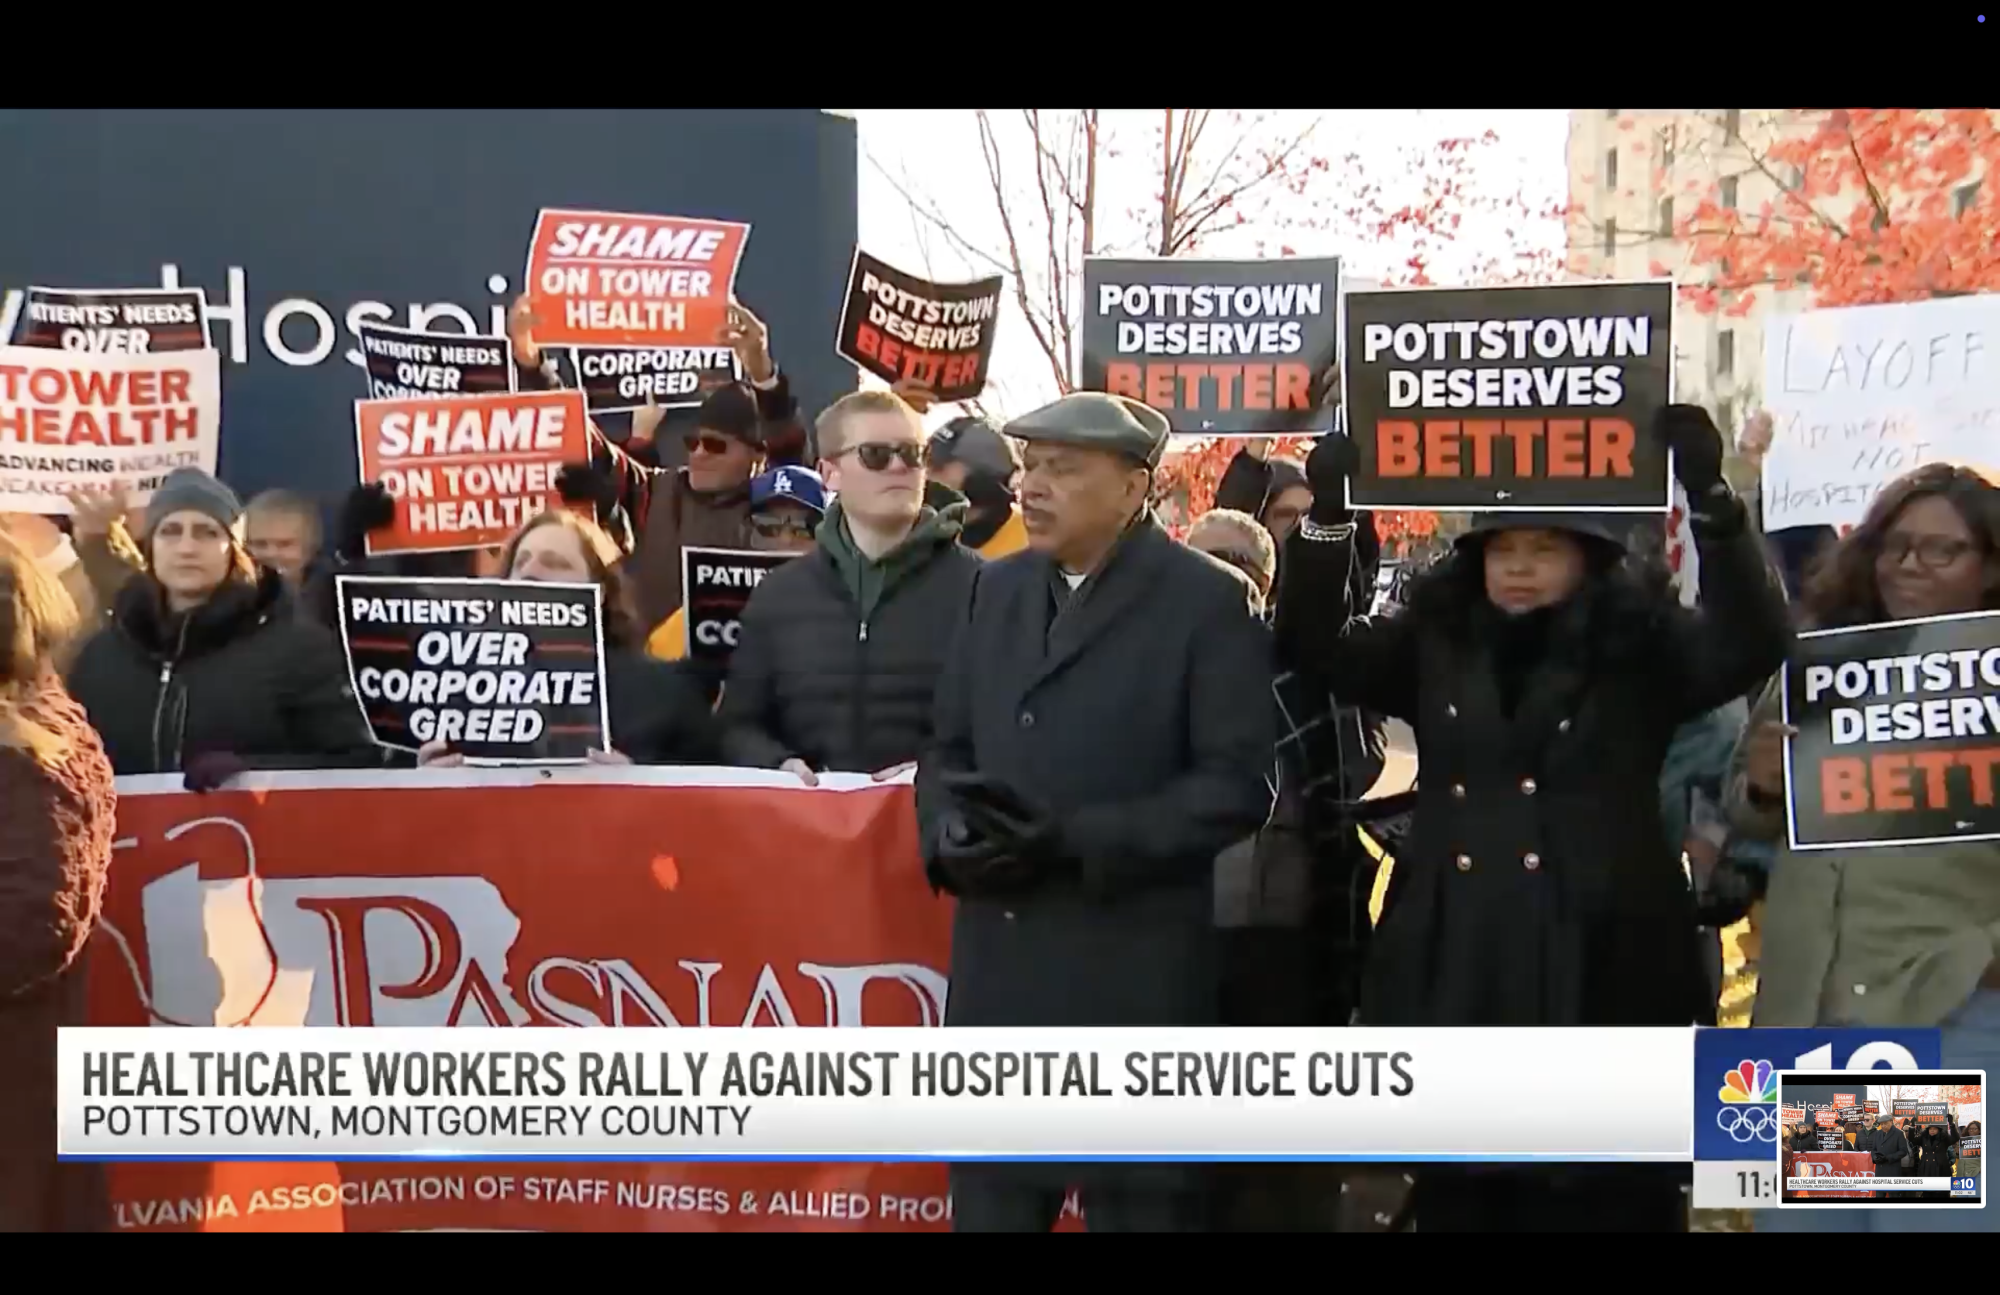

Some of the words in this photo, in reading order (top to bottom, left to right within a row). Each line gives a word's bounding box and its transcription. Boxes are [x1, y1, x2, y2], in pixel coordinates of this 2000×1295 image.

[548, 222, 725, 261] SHAME
[541, 267, 590, 295] ON
[599, 268, 712, 297] TOWER
[862, 270, 994, 325] POTTSTOWN
[1099, 283, 1322, 317] POTTSTOWN
[124, 303, 197, 324] NEEDS
[565, 300, 686, 331] HEALTH
[869, 301, 981, 350] DESERVES
[61, 328, 150, 353] OVER
[365, 336, 437, 362] PATIENTS'
[441, 346, 502, 366] NEEDS
[857, 322, 979, 388] BETTER
[1117, 321, 1302, 355] DESERVES
[1364, 316, 1650, 362] POTTSTOWN
[397, 363, 462, 390] OVER
[583, 349, 730, 377] CORPORATE
[1783, 323, 1984, 393] LAYOFF
[0, 364, 191, 407] TOWER
[618, 371, 699, 398] GREED
[1107, 361, 1311, 412] BETTER
[1388, 366, 1623, 408] DESERVES
[0, 407, 198, 447] HEALTH
[378, 406, 566, 457] SHAME
[0, 455, 114, 473] ADVANCING
[1376, 418, 1636, 477] BETTER
[379, 468, 434, 499] ON
[351, 598, 494, 625] PATIENTS'
[501, 601, 587, 627] NEEDS
[417, 630, 530, 666] OVER
[359, 666, 596, 705] CORPORATE
[409, 707, 544, 742] GREED
[1820, 747, 2000, 816] BETT
[113, 1194, 238, 1228] LVANIA
[247, 1175, 465, 1214] ASSOCIATION
[474, 1175, 515, 1202] OF
[523, 1177, 609, 1203] STAFF
[616, 1183, 730, 1215] NURSES
[739, 1191, 759, 1215] &
[767, 1190, 871, 1220] ALLIED
